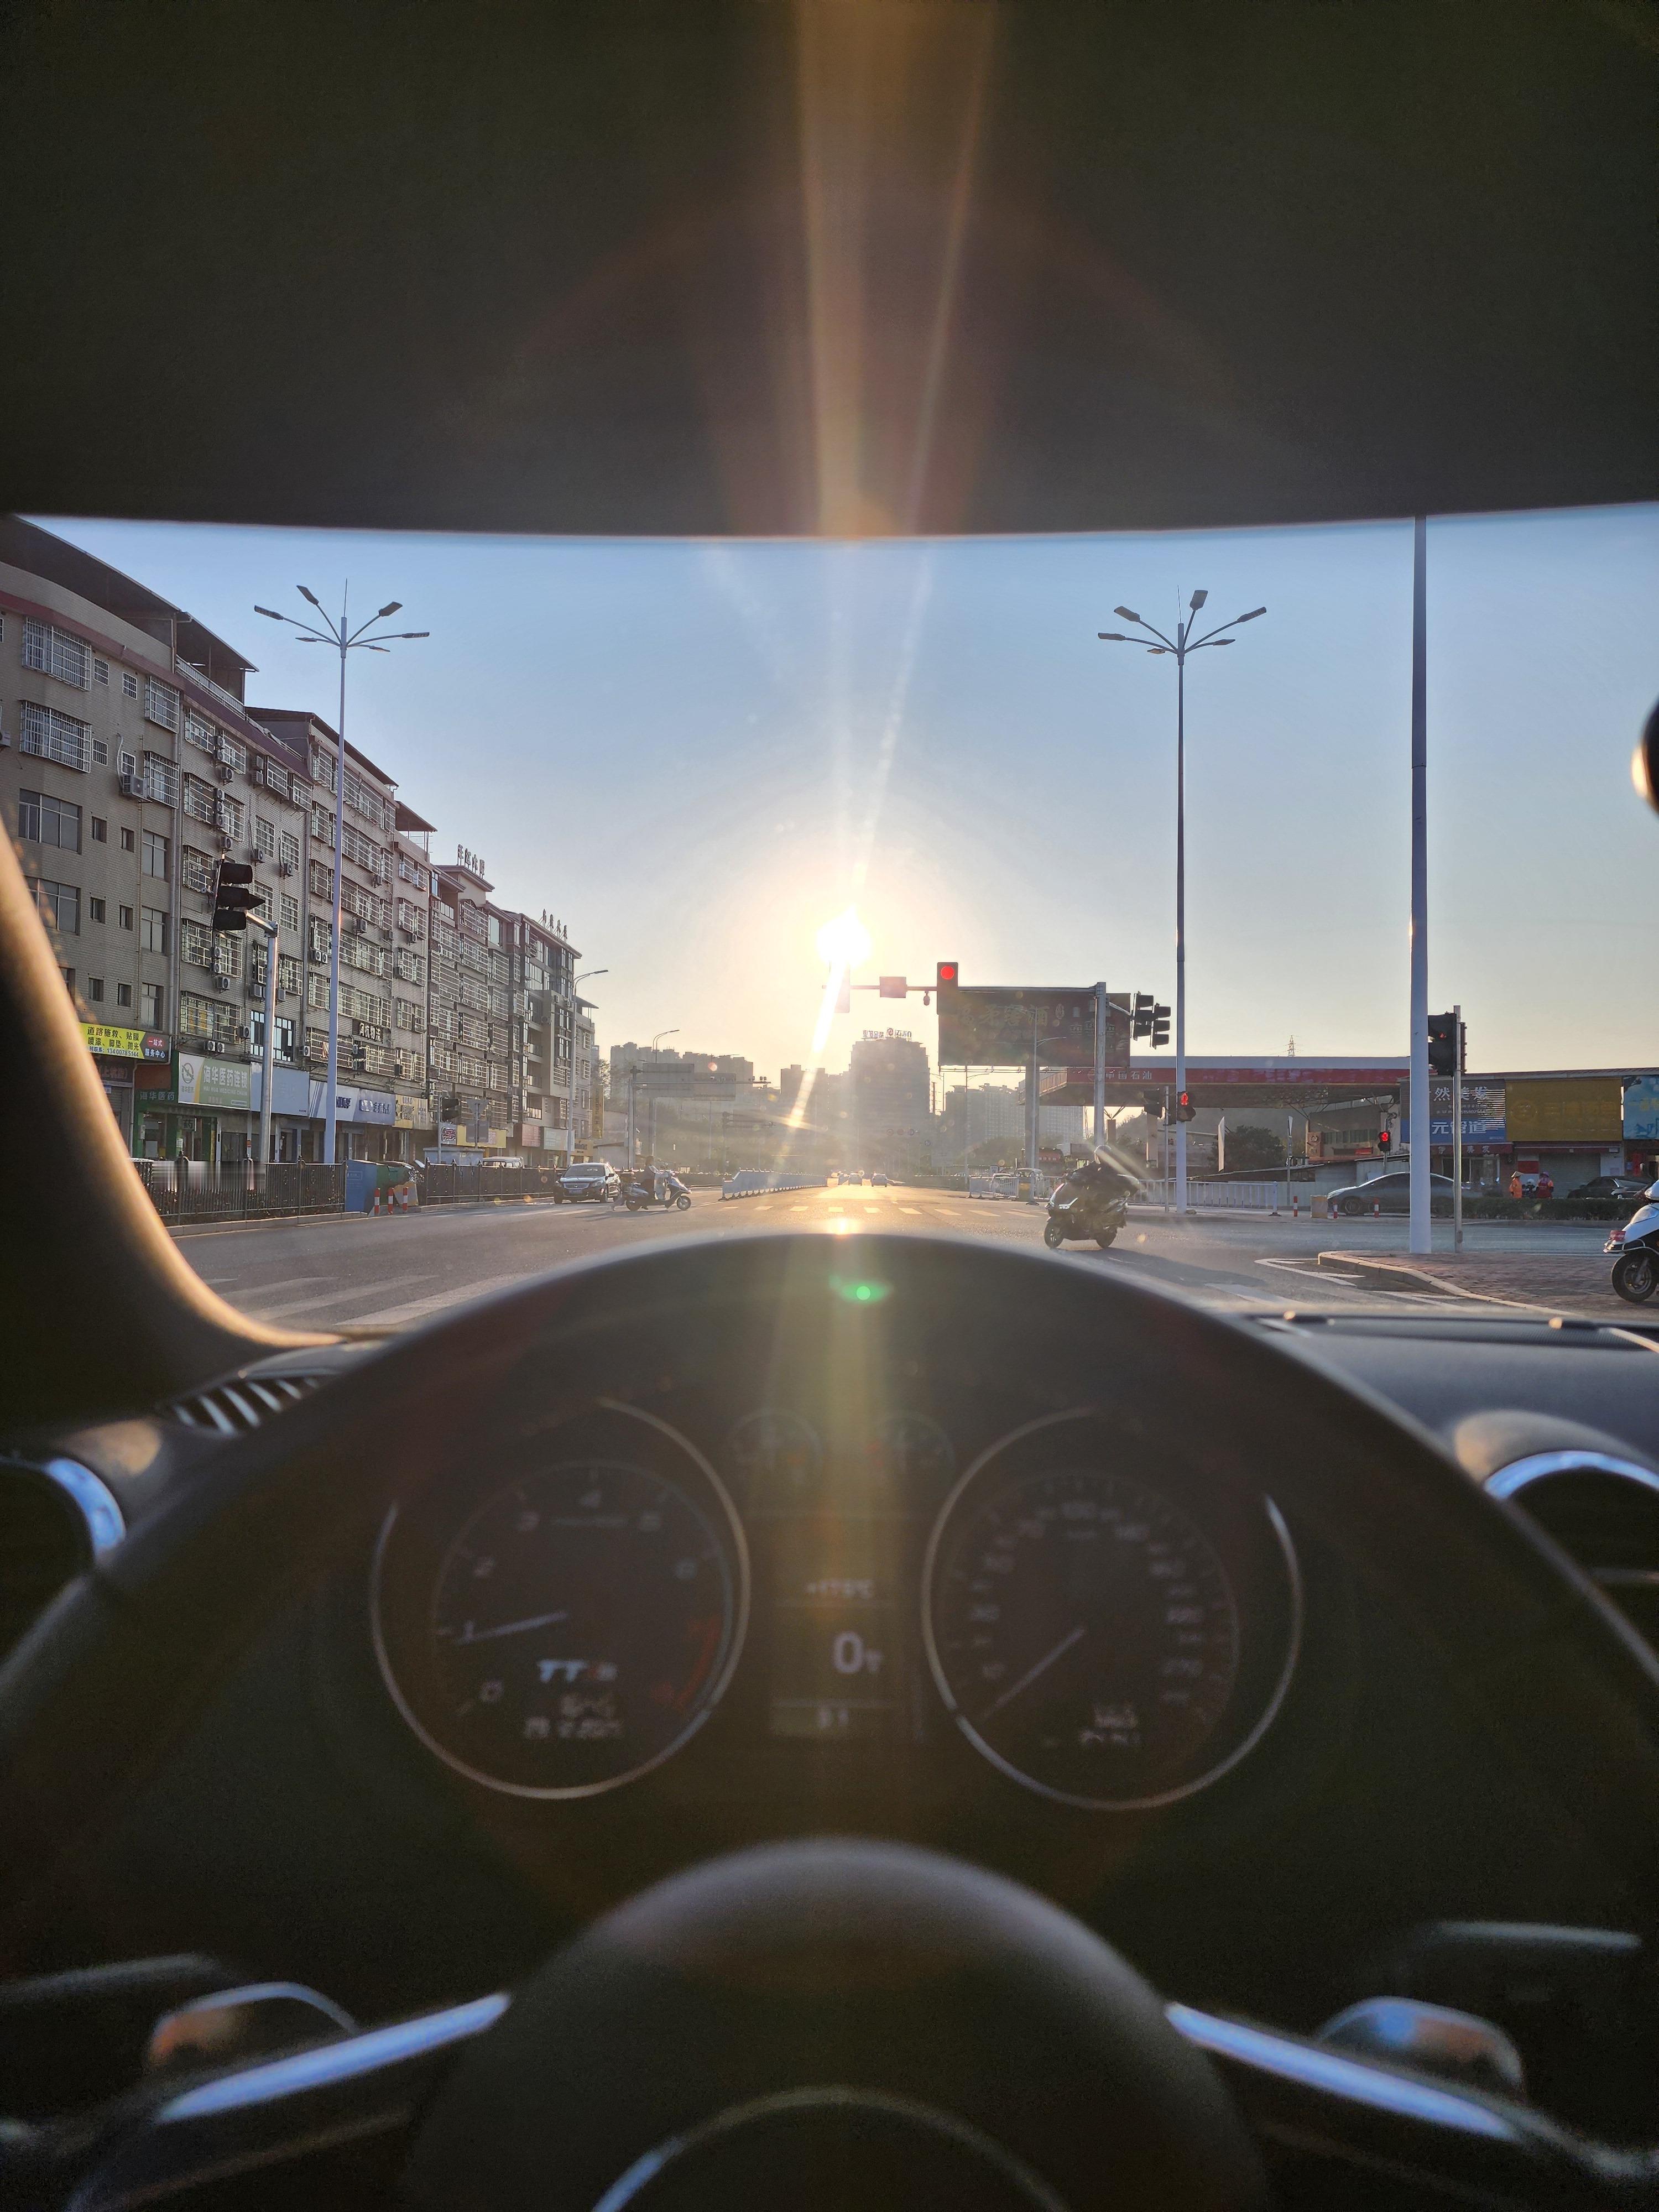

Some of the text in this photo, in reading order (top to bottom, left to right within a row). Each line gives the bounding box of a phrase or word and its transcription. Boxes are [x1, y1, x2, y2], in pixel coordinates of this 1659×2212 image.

[145, 1048, 165, 1058] 服务中心
[204, 1065, 248, 1088] 海华医药连锁
[1105, 1071, 1152, 1080] 中国石油
[1429, 1087, 1487, 1101] 然美发
